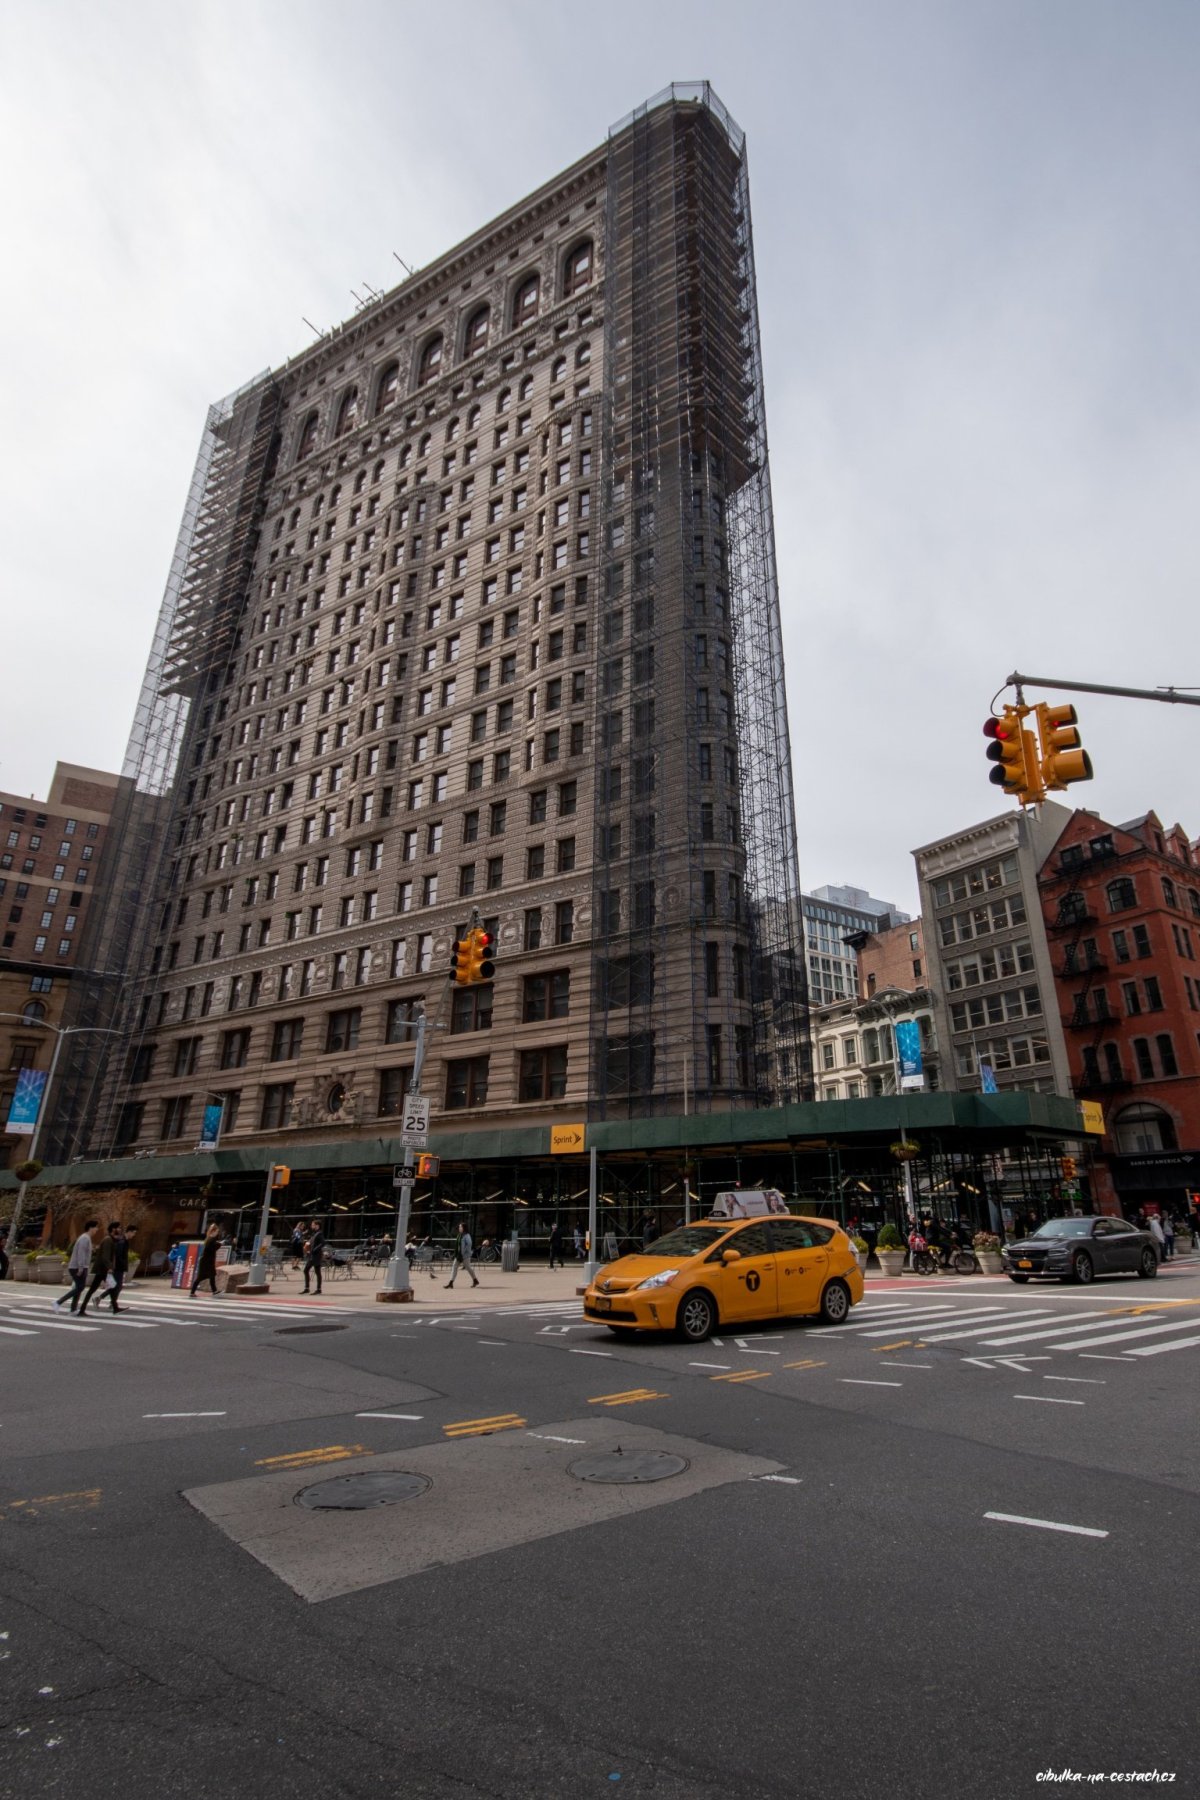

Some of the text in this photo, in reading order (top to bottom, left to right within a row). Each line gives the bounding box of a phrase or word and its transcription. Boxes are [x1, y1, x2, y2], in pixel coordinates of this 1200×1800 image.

[405, 1116, 426, 1131] 25
[553, 1135, 573, 1145] Sprint
[179, 1198, 208, 1208] CAFE
